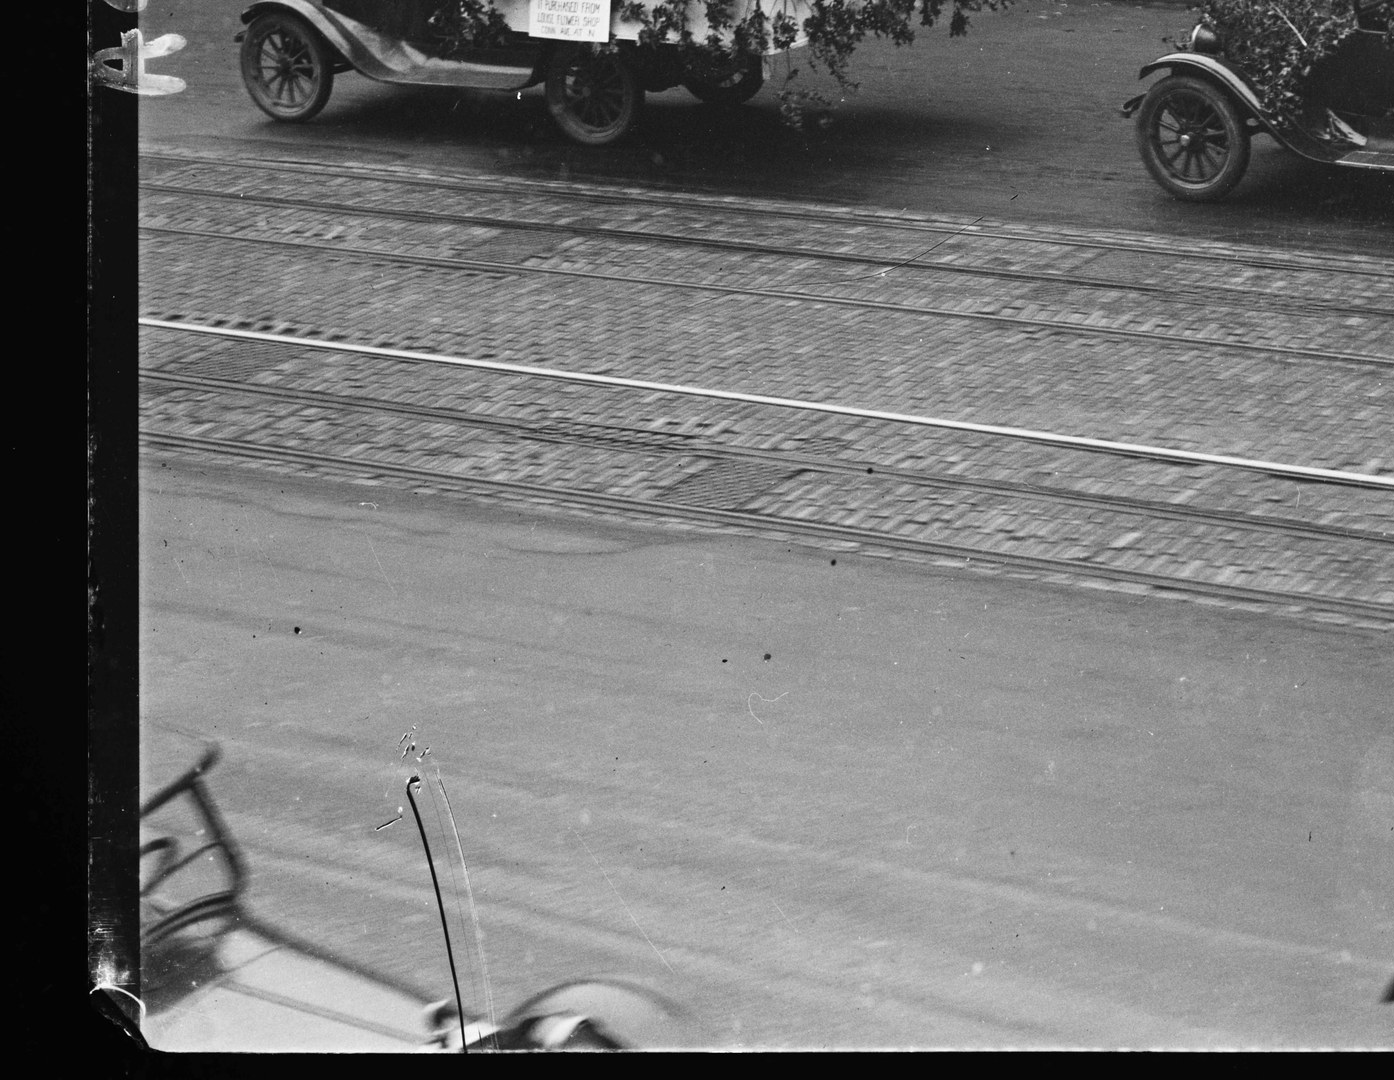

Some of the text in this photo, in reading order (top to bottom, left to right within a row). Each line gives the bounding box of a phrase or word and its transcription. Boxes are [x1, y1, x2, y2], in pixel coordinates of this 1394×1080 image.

[545, 0, 578, 13] PURCHASED
[581, 1, 601, 14] FROM
[556, 14, 580, 26] FLOWER
[583, 16, 601, 27] SHOP
